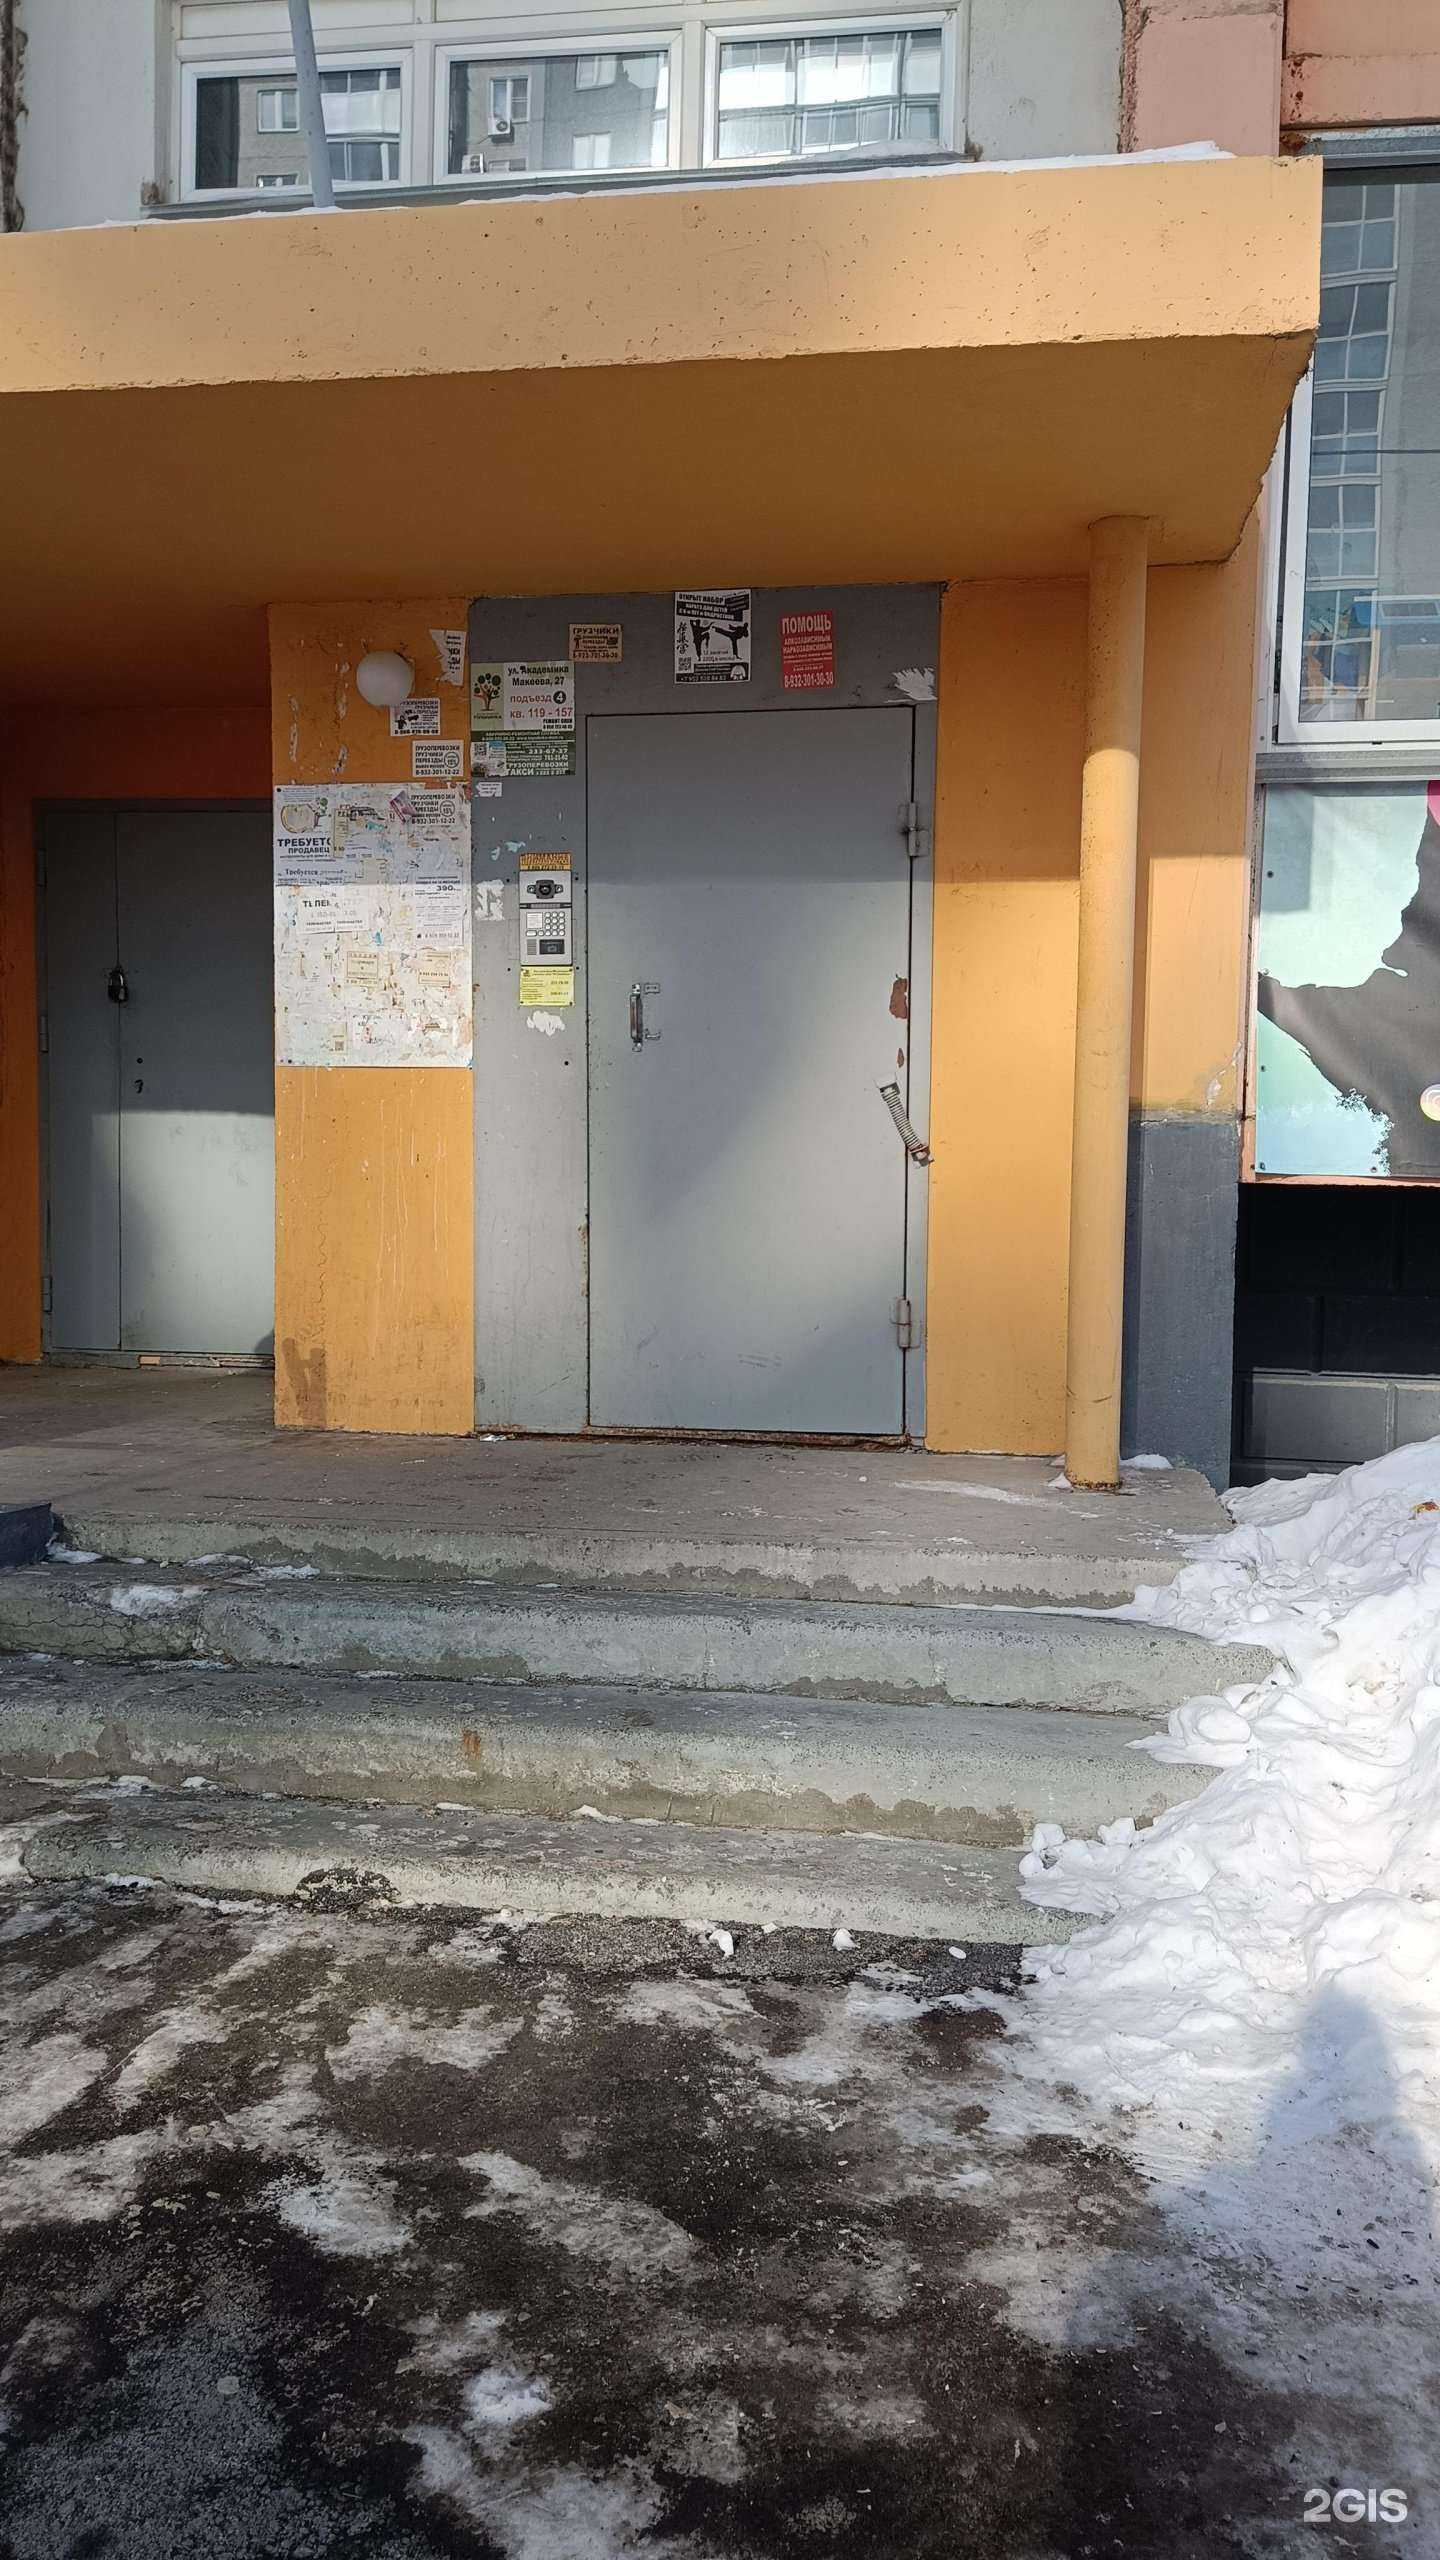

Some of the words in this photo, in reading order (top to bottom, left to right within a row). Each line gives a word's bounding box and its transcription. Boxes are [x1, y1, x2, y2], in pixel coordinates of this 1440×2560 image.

[782, 614, 832, 634] ПОМОЩЬ
[520, 666, 569, 675] Академика
[512, 678, 553, 686] Макеева,
[554, 676, 565, 686] 27
[784, 672, 834, 688] 8-932-301-30-30
[510, 694, 552, 704] подъезд
[556, 692, 564, 702] 4
[510, 710, 525, 719] кв.
[528, 708, 546, 718] 119
[555, 708, 573, 717] 157
[285, 868, 318, 877] Требуется
